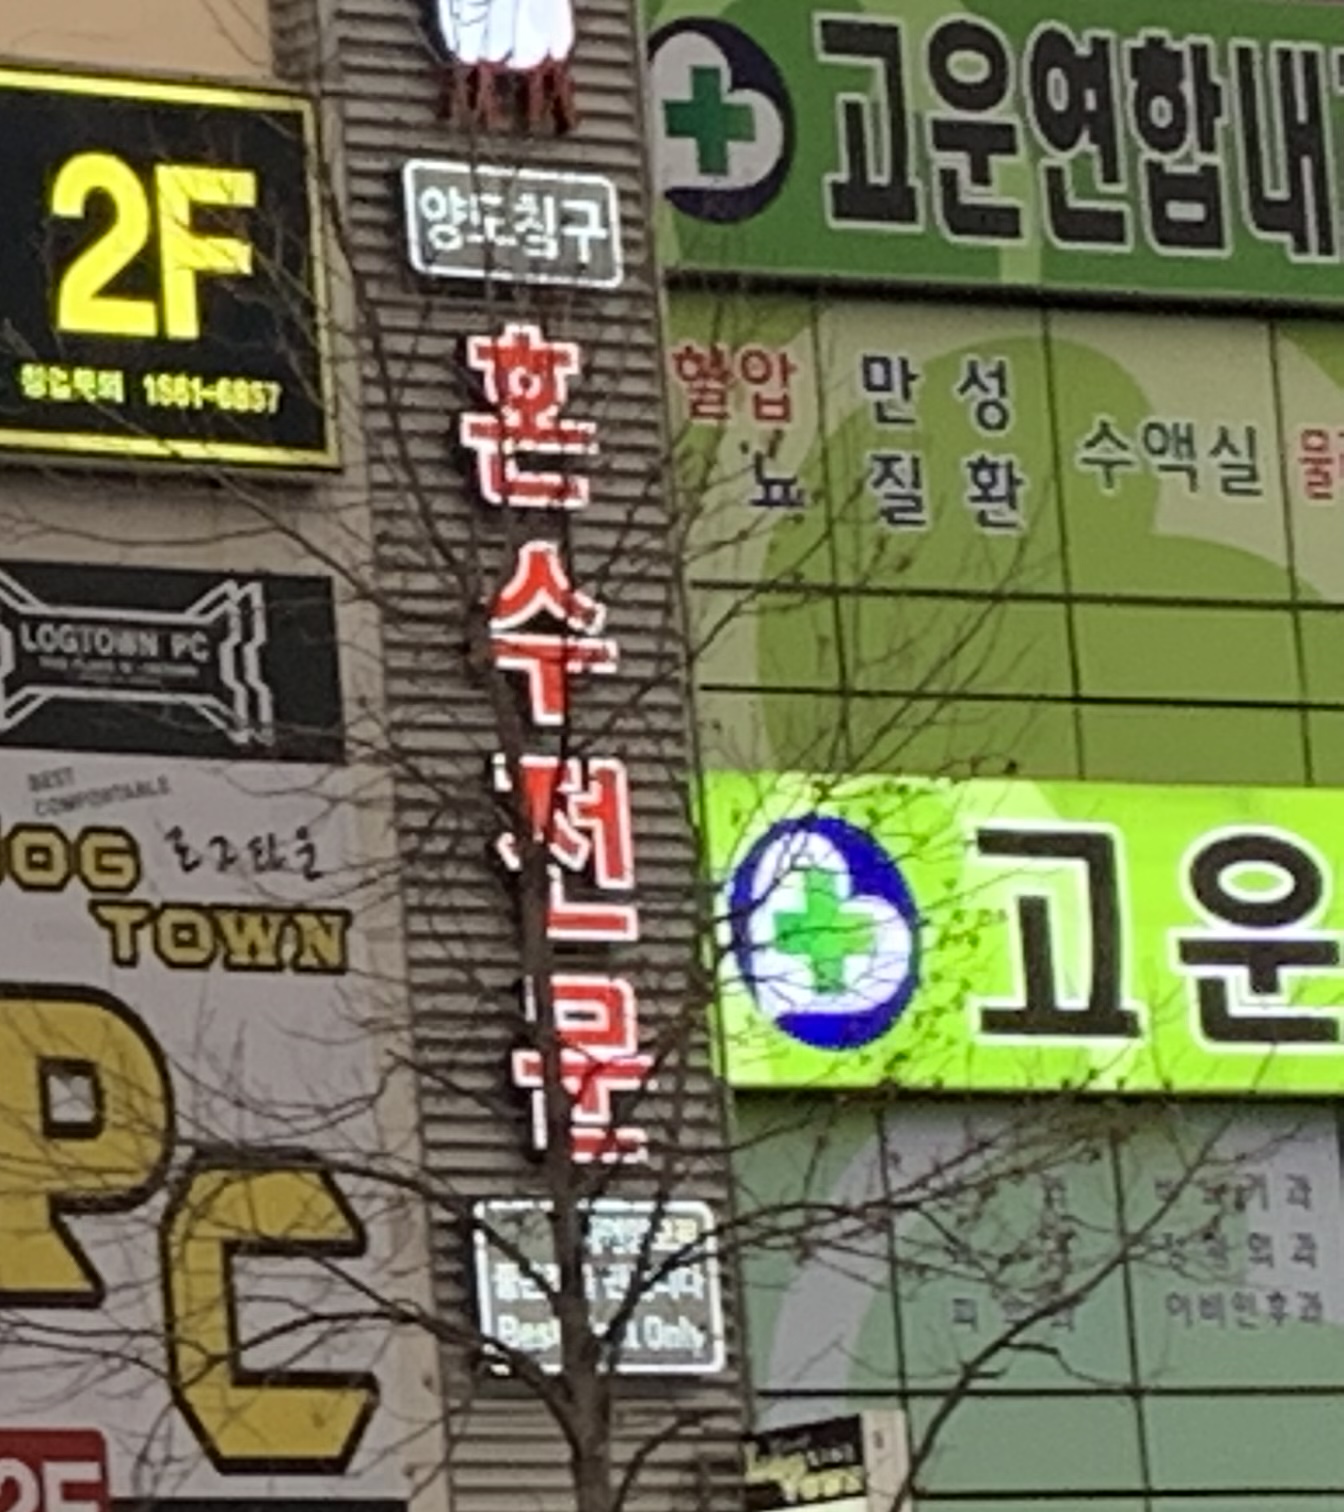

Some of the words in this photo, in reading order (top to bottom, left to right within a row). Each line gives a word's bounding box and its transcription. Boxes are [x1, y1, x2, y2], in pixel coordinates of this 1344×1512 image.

[814, 12, 1344, 263] 고운연합내
[50, 152, 257, 341] 2F
[419, 184, 609, 264] 양모침구
[860, 353, 1010, 432] 만성
[869, 453, 1025, 529] 질환
[1079, 419, 1264, 497] 수액실
[1298, 427, 1344, 501] 물
[20, 622, 160, 657] LOGTOWN
[170, 631, 210, 662] PC
[460, 324, 655, 1165] 혼수전문
[89, 899, 352, 975] TOWN
[972, 822, 1343, 1046] 고운
[1166, 1291, 1323, 1331] 이비인후과
